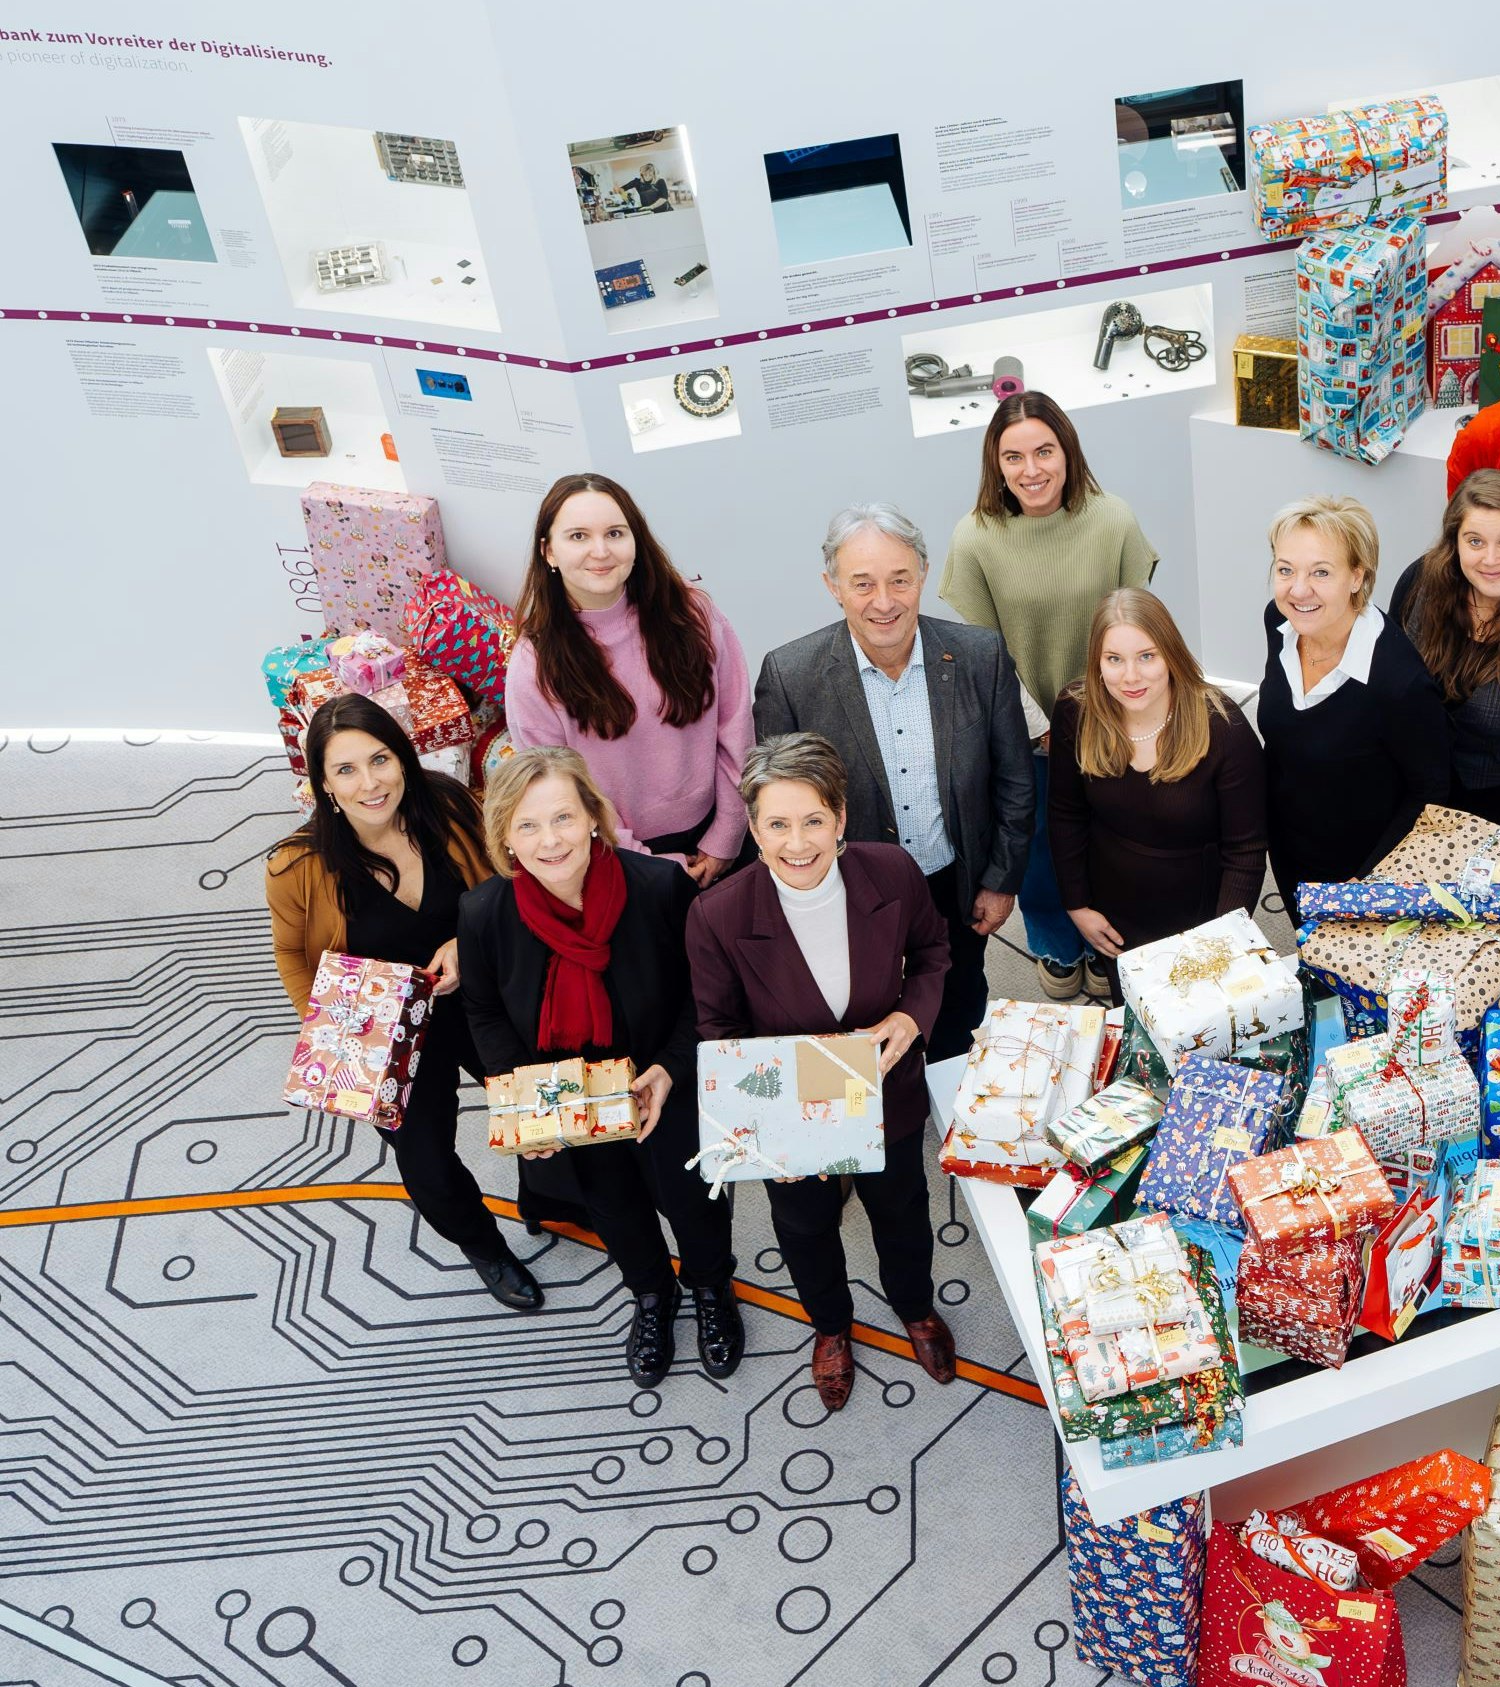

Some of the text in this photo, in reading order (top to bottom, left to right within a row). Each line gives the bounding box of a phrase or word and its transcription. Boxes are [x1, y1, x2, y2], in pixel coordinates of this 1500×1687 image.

[0, 28, 333, 68] bank zum Vorreiter der Digitalisierung.
[8, 50, 193, 73] pioneer of digitalization.
[276, 542, 323, 613] 1980
[1258, 1533, 1279, 1551] HO
[1234, 1658, 1290, 1687] Christm
[1263, 1650, 1312, 1684] Merry
